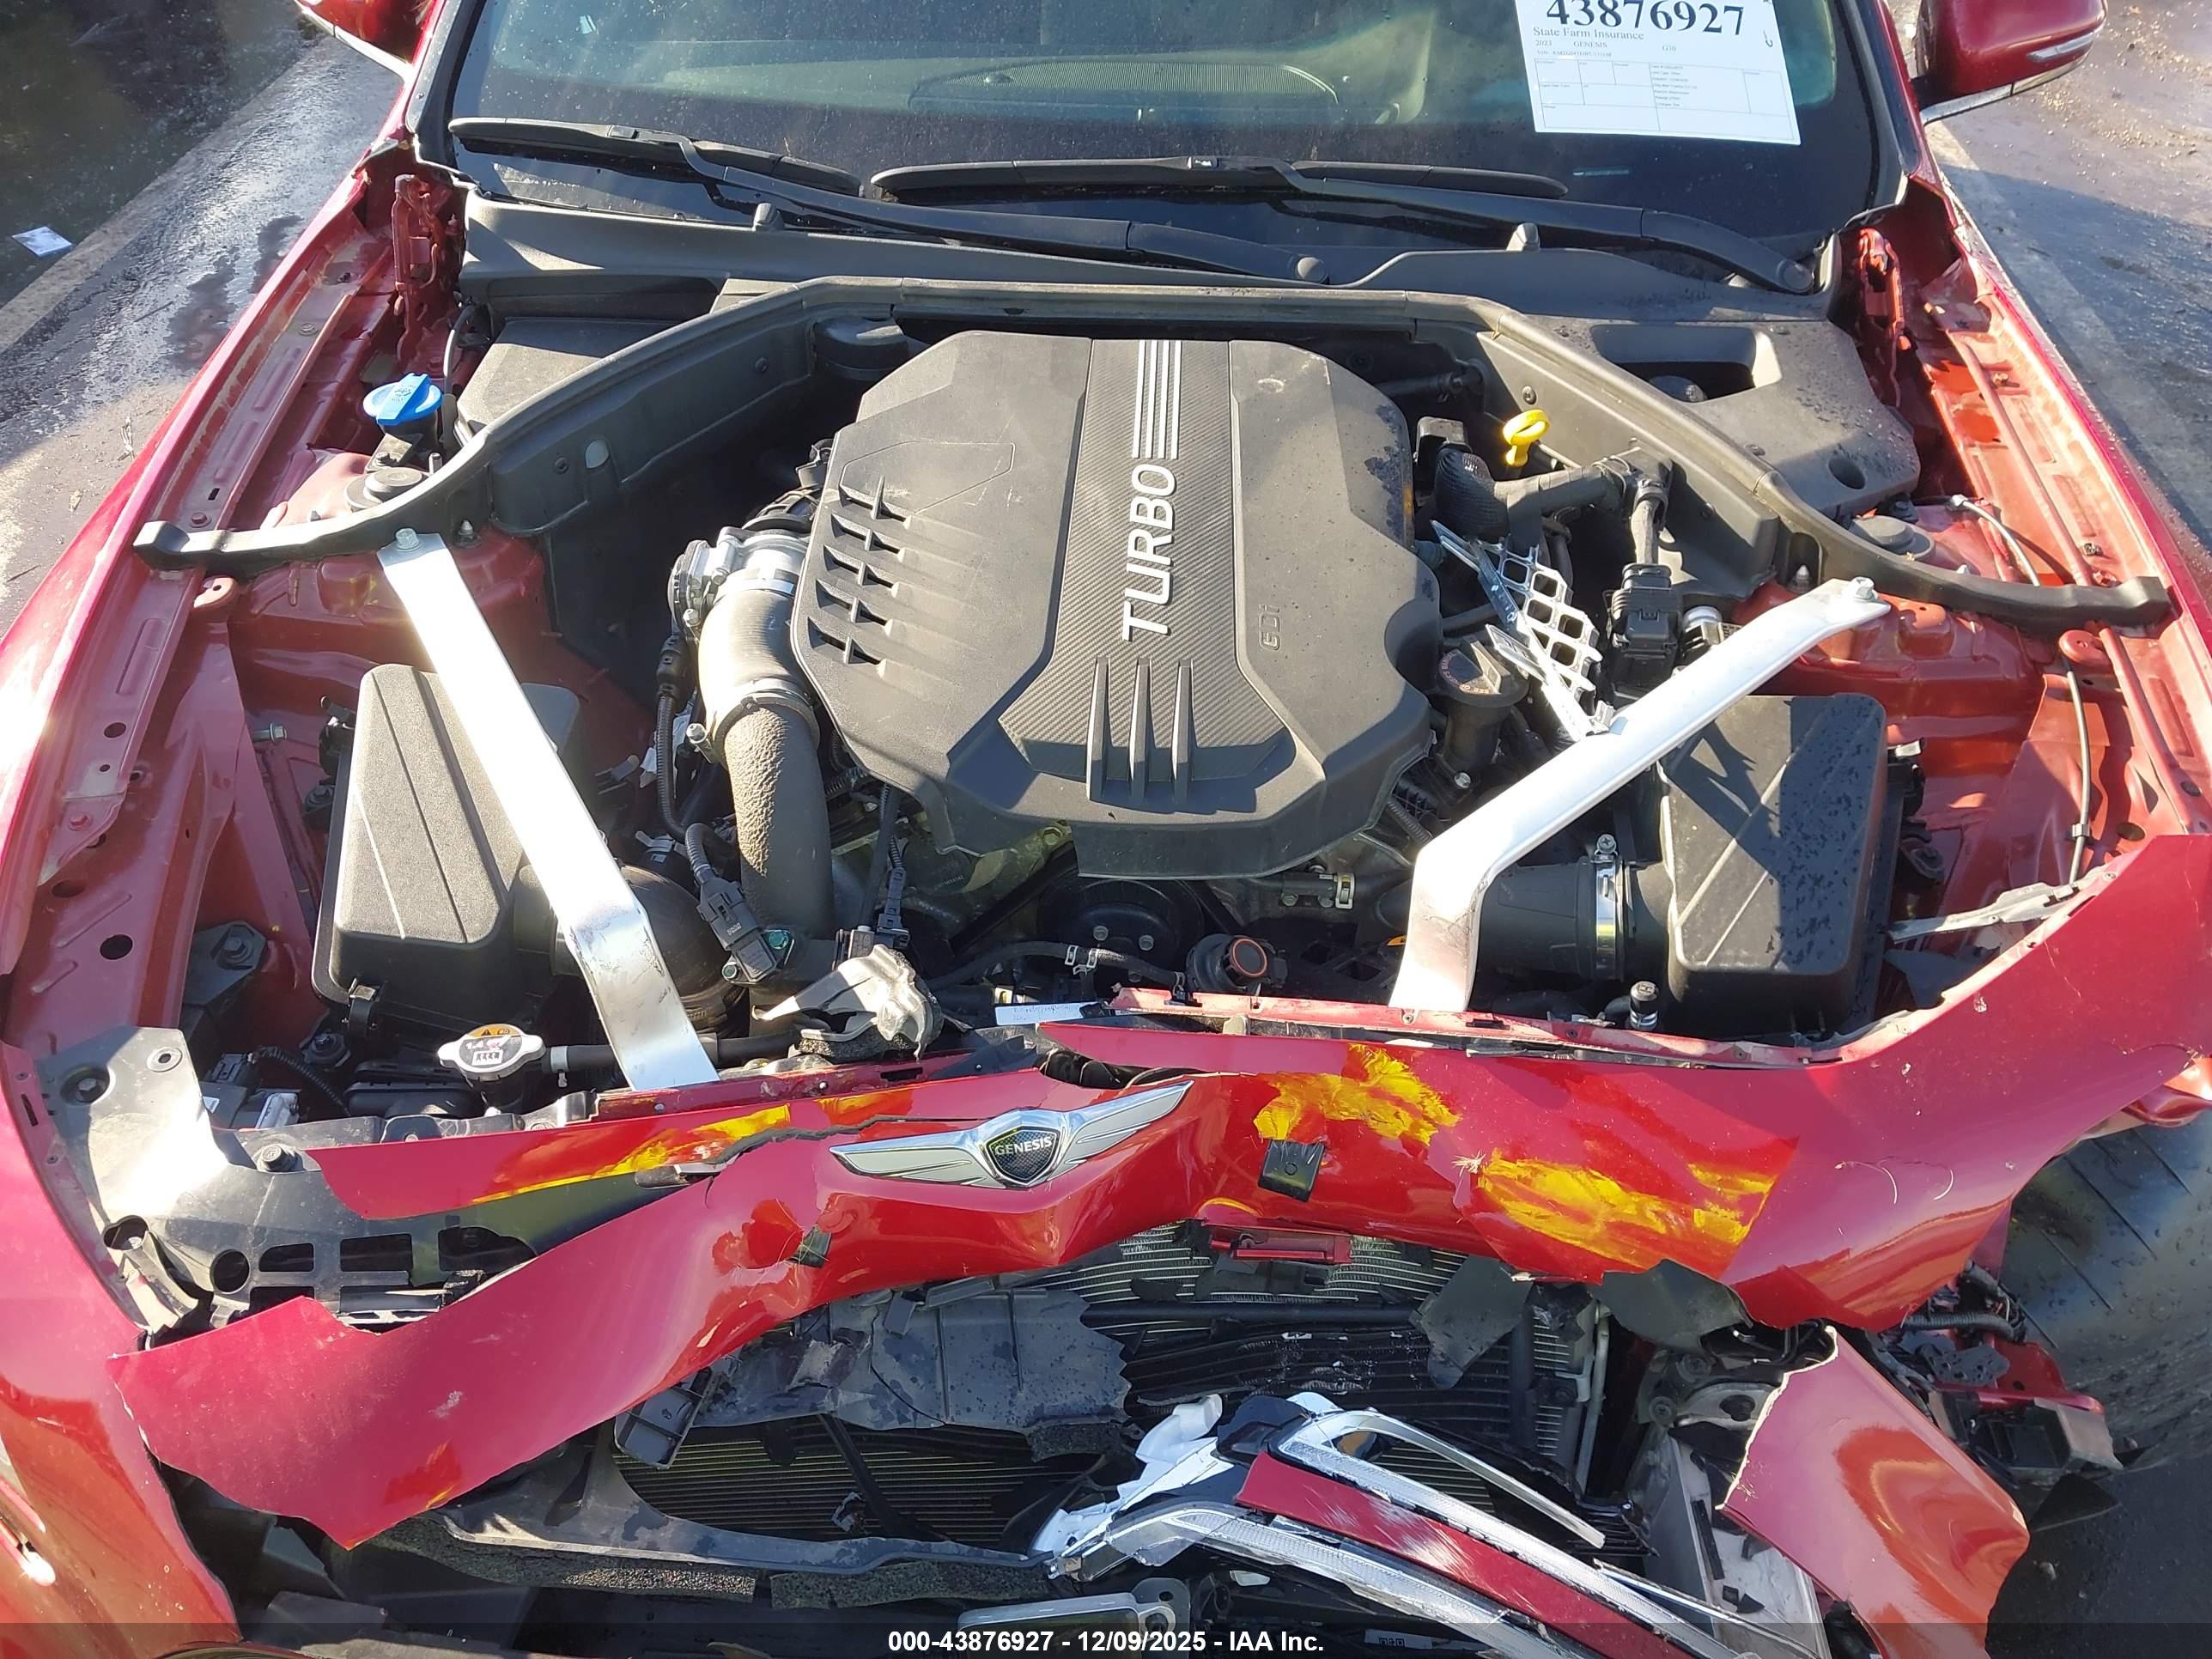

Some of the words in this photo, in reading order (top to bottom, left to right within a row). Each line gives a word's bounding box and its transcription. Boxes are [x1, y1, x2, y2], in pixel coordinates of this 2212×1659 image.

[1546, 0, 1745, 35] 43876927
[1533, 27, 1560, 37] State
[1564, 27, 1591, 39] Farm
[1595, 29, 1644, 40] Insurance
[1121, 464, 1177, 641] TURBO
[994, 1137, 1052, 1154] GENESIS
